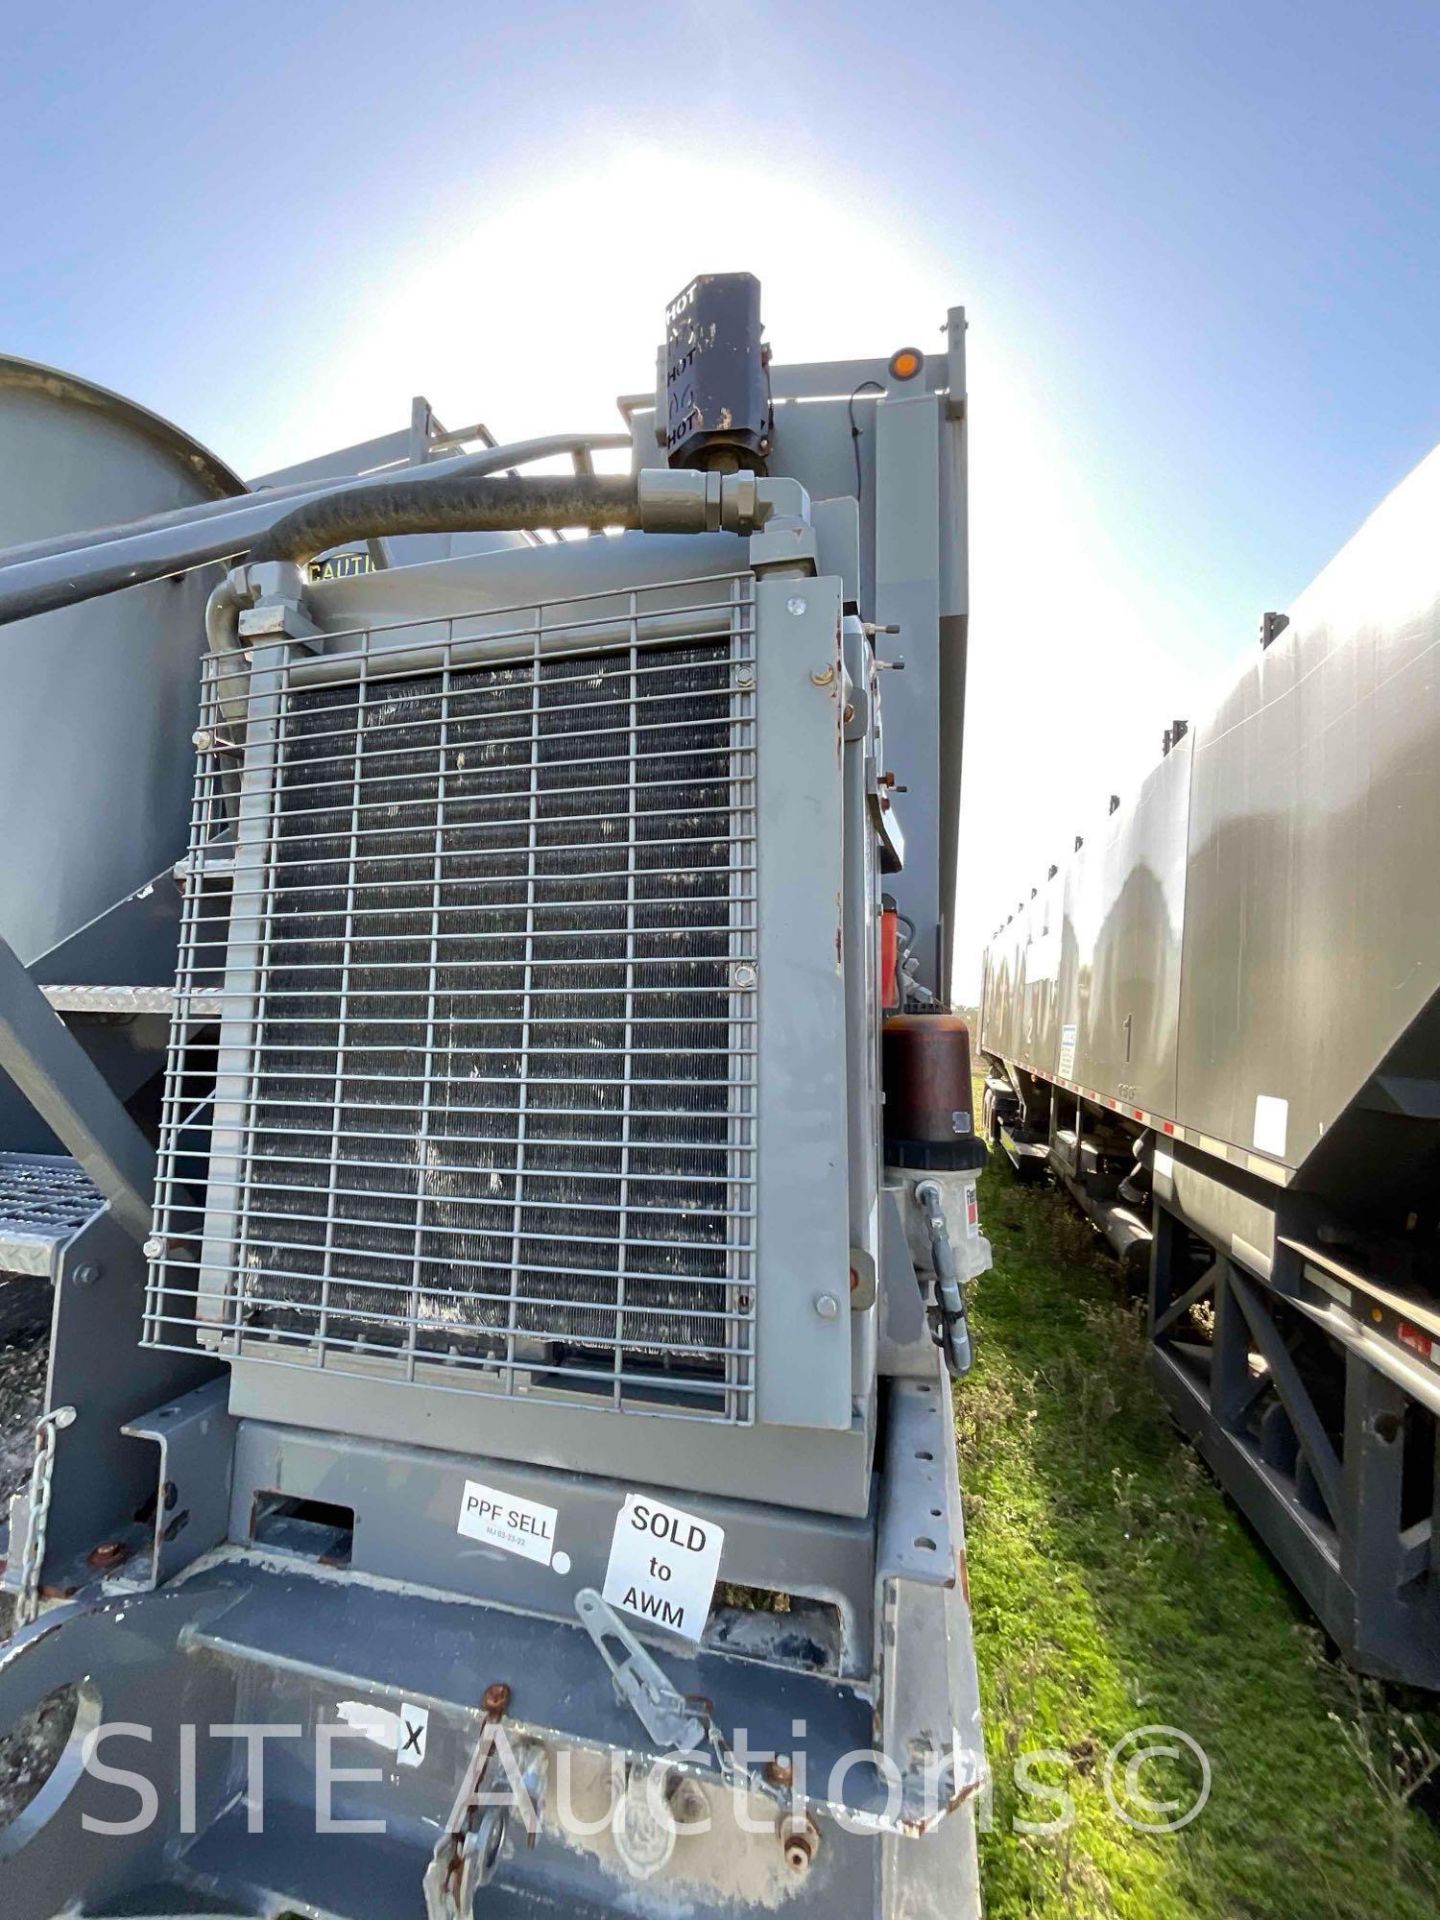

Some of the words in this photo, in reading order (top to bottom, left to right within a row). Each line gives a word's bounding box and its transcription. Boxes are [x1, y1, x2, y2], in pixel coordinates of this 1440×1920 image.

[666, 283, 697, 325] HOT
[667, 348, 696, 387] HOT
[667, 411, 697, 449] HOT
[311, 554, 377, 583] CAUTI
[467, 1496, 503, 1520] PPF
[507, 1510, 551, 1539] SELL
[631, 1505, 706, 1552] SOLD
[649, 1557, 671, 1581] to
[623, 1587, 684, 1628] AWM
